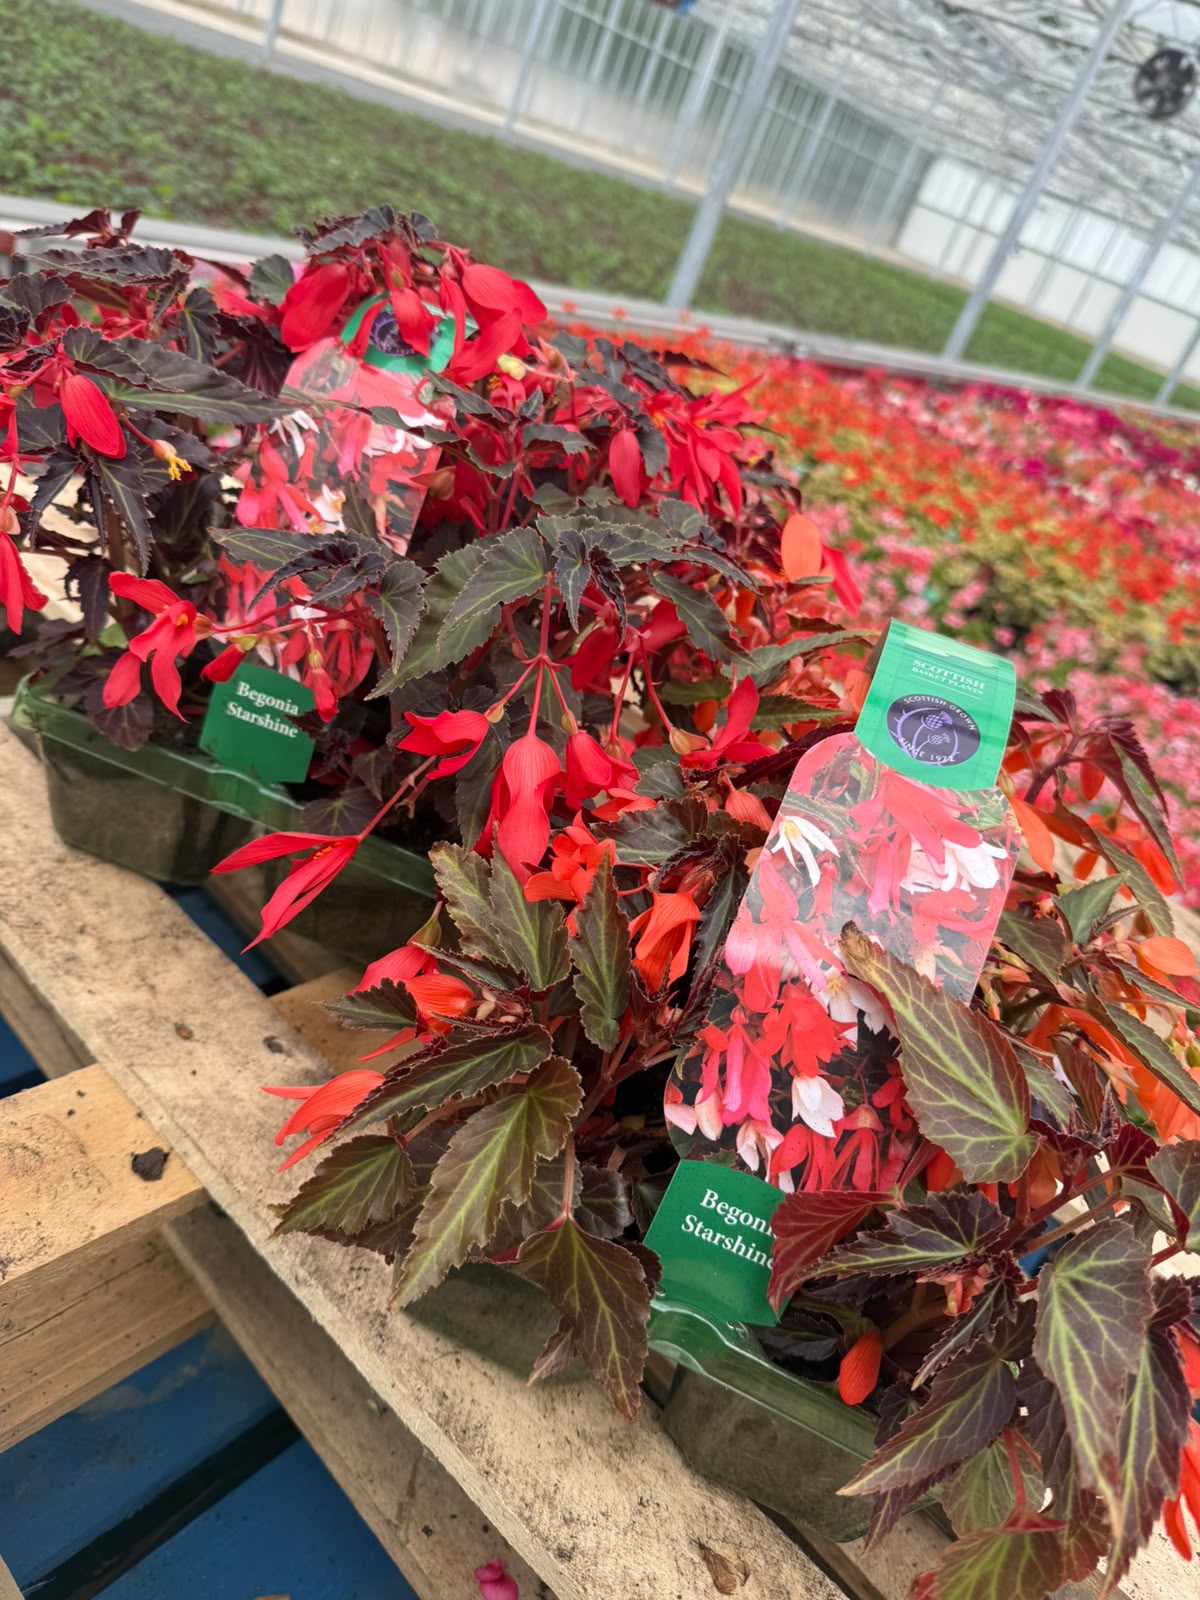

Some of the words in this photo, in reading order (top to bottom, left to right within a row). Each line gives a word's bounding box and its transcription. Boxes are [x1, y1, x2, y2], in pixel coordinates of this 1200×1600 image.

[912, 659, 984, 690] SCOTTISH
[912, 667, 946, 683] BASKET
[947, 678, 984, 695] PLANTS
[237, 682, 299, 715] Begonia
[903, 696, 947, 707] SCOTTISH
[949, 704, 977, 731] GROWN
[226, 702, 298, 738] Starshine
[898, 737, 925, 758] SINCE
[700, 1189, 777, 1239] Begon
